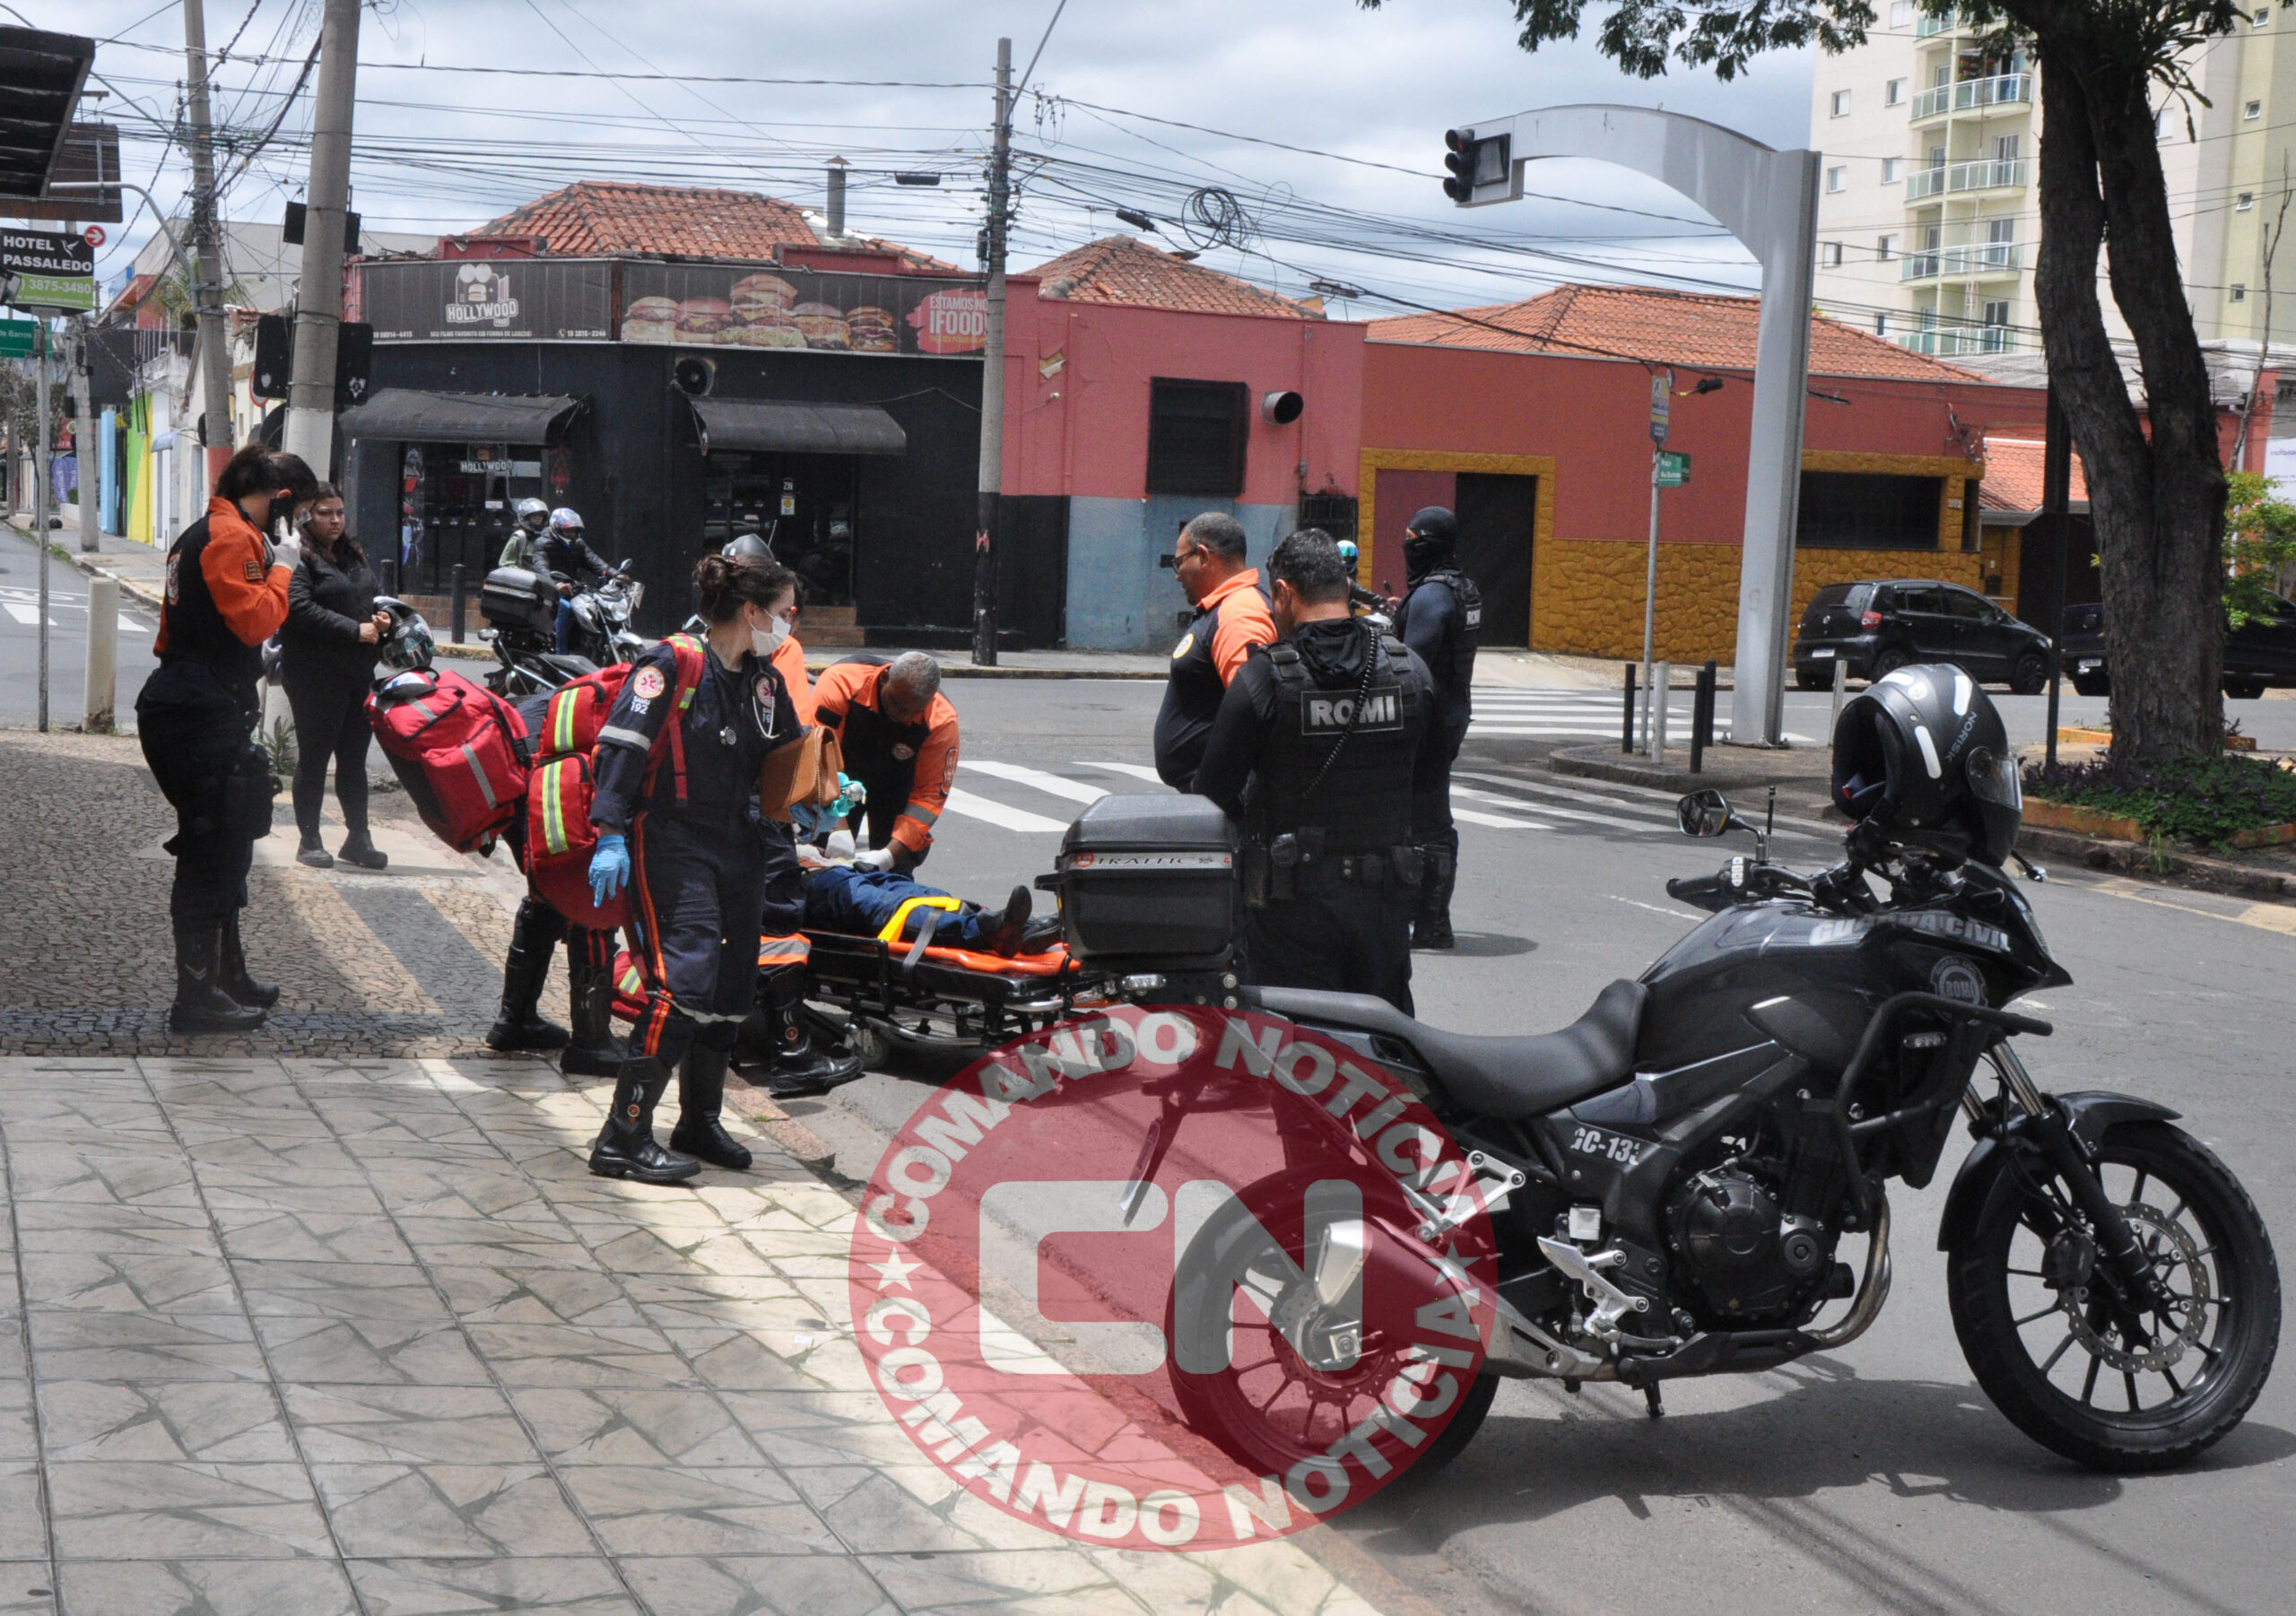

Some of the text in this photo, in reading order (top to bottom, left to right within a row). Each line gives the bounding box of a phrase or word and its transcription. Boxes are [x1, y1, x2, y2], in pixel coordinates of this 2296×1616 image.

[4, 235, 55, 251] HOTEL
[3, 254, 92, 272] PASSALEDO
[30, 279, 91, 294] 3875-3480
[447, 300, 517, 321] HOLLYWOOD
[929, 296, 973, 310] ESTAMOS
[1466, 608, 1481, 625] ROM
[630, 701, 648, 715] 192
[1309, 694, 1396, 727] ROMI
[762, 713, 772, 724] 19
[1944, 710, 1978, 763] NORISK
[1946, 917, 2012, 952] CIVIL
